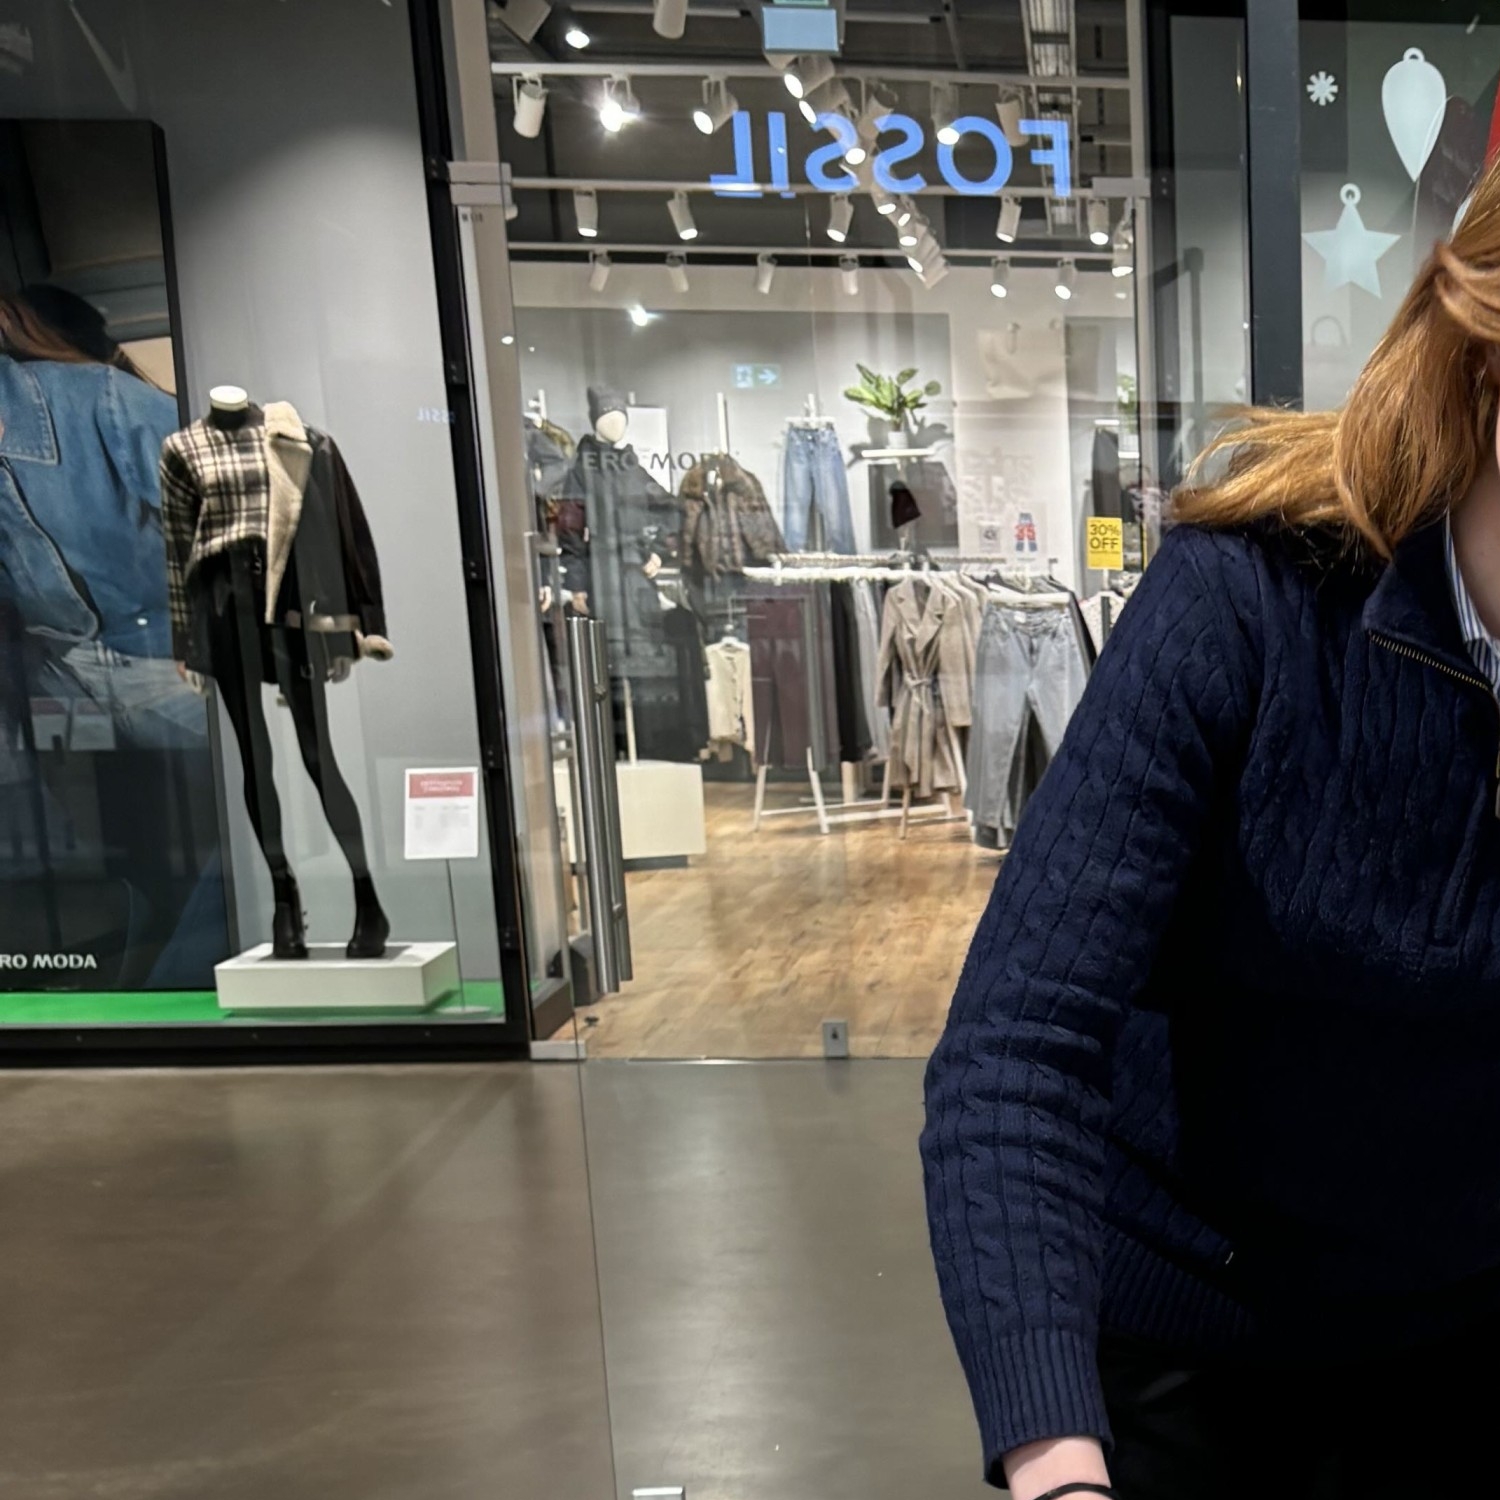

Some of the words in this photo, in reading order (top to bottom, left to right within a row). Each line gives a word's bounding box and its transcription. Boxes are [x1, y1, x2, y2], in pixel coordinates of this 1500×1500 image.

[1090, 523, 1121, 536] 30%
[1090, 536, 1119, 549] OFF
[32, 953, 98, 969] MODA
